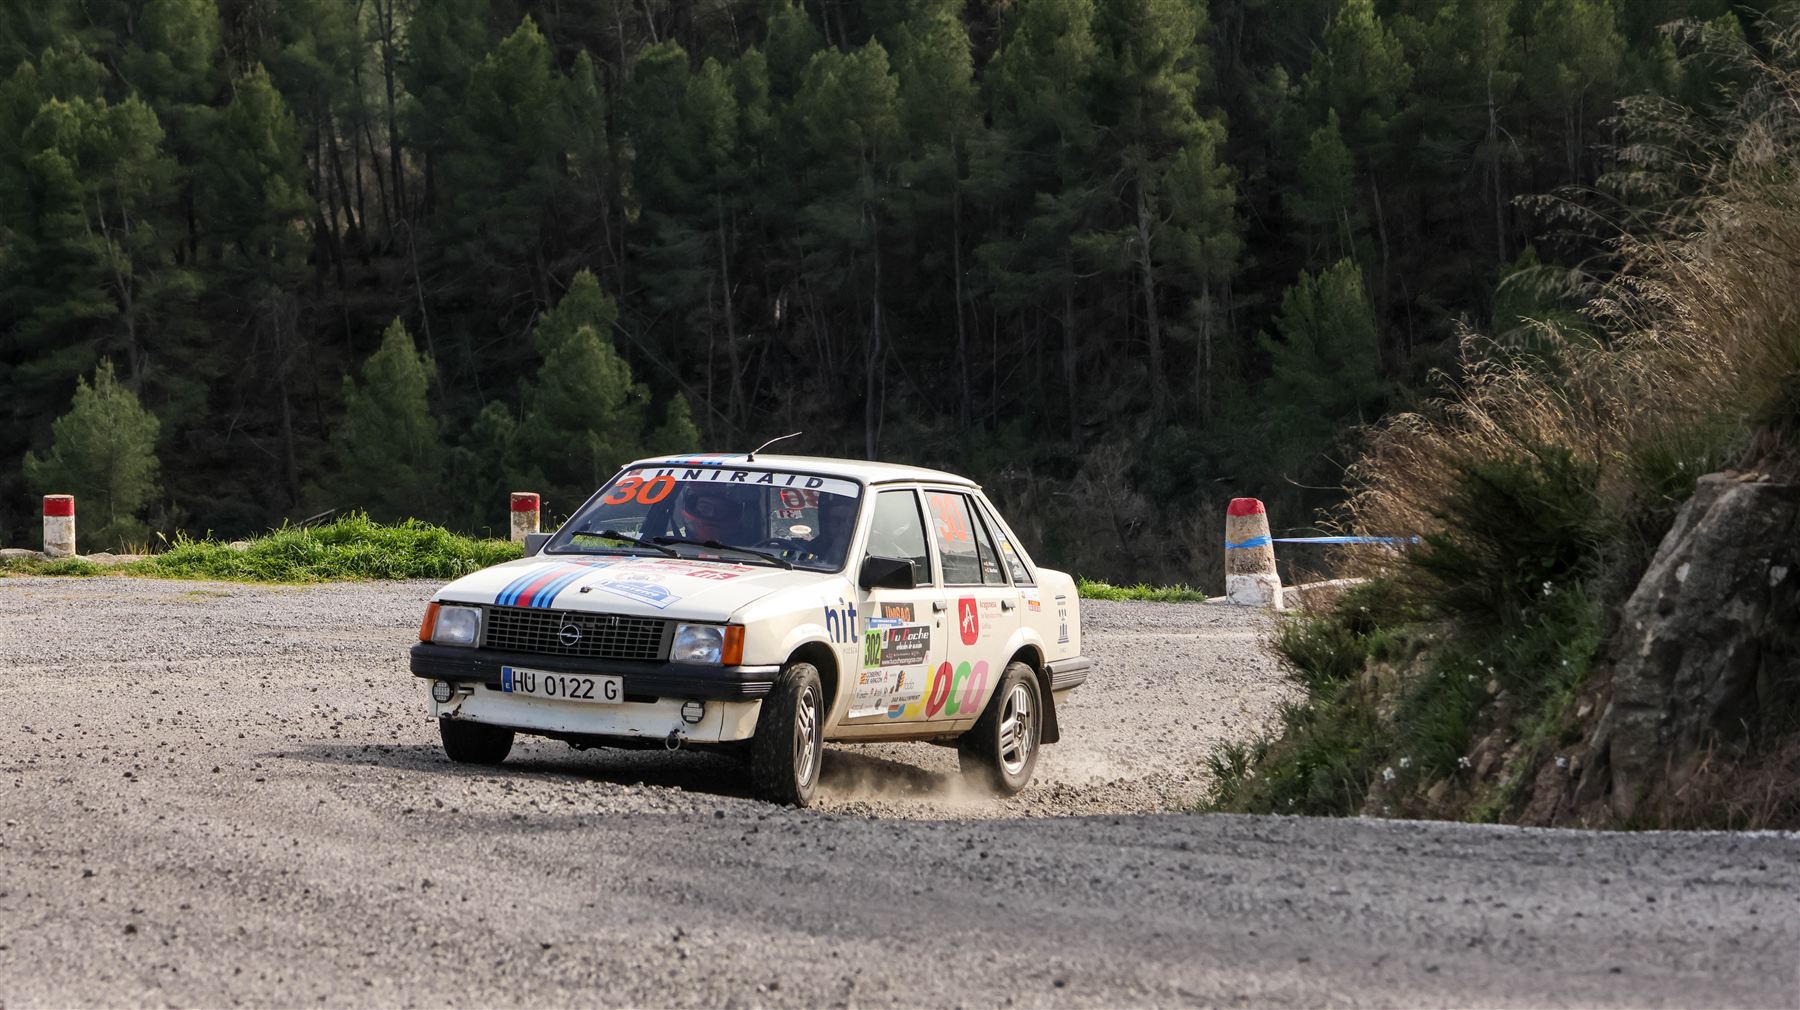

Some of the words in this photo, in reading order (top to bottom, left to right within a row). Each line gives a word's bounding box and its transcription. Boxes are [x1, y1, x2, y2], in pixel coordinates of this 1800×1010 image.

[604, 475, 676, 505] 30
[655, 469, 824, 489] UNIRAID
[930, 495, 967, 544] 30
[824, 597, 858, 643] hit
[890, 629, 901, 642] Tu
[901, 627, 929, 641] Coche
[865, 633, 881, 665] 302
[512, 670, 536, 693] HU
[544, 675, 595, 699] 0122
[604, 680, 617, 700] G
